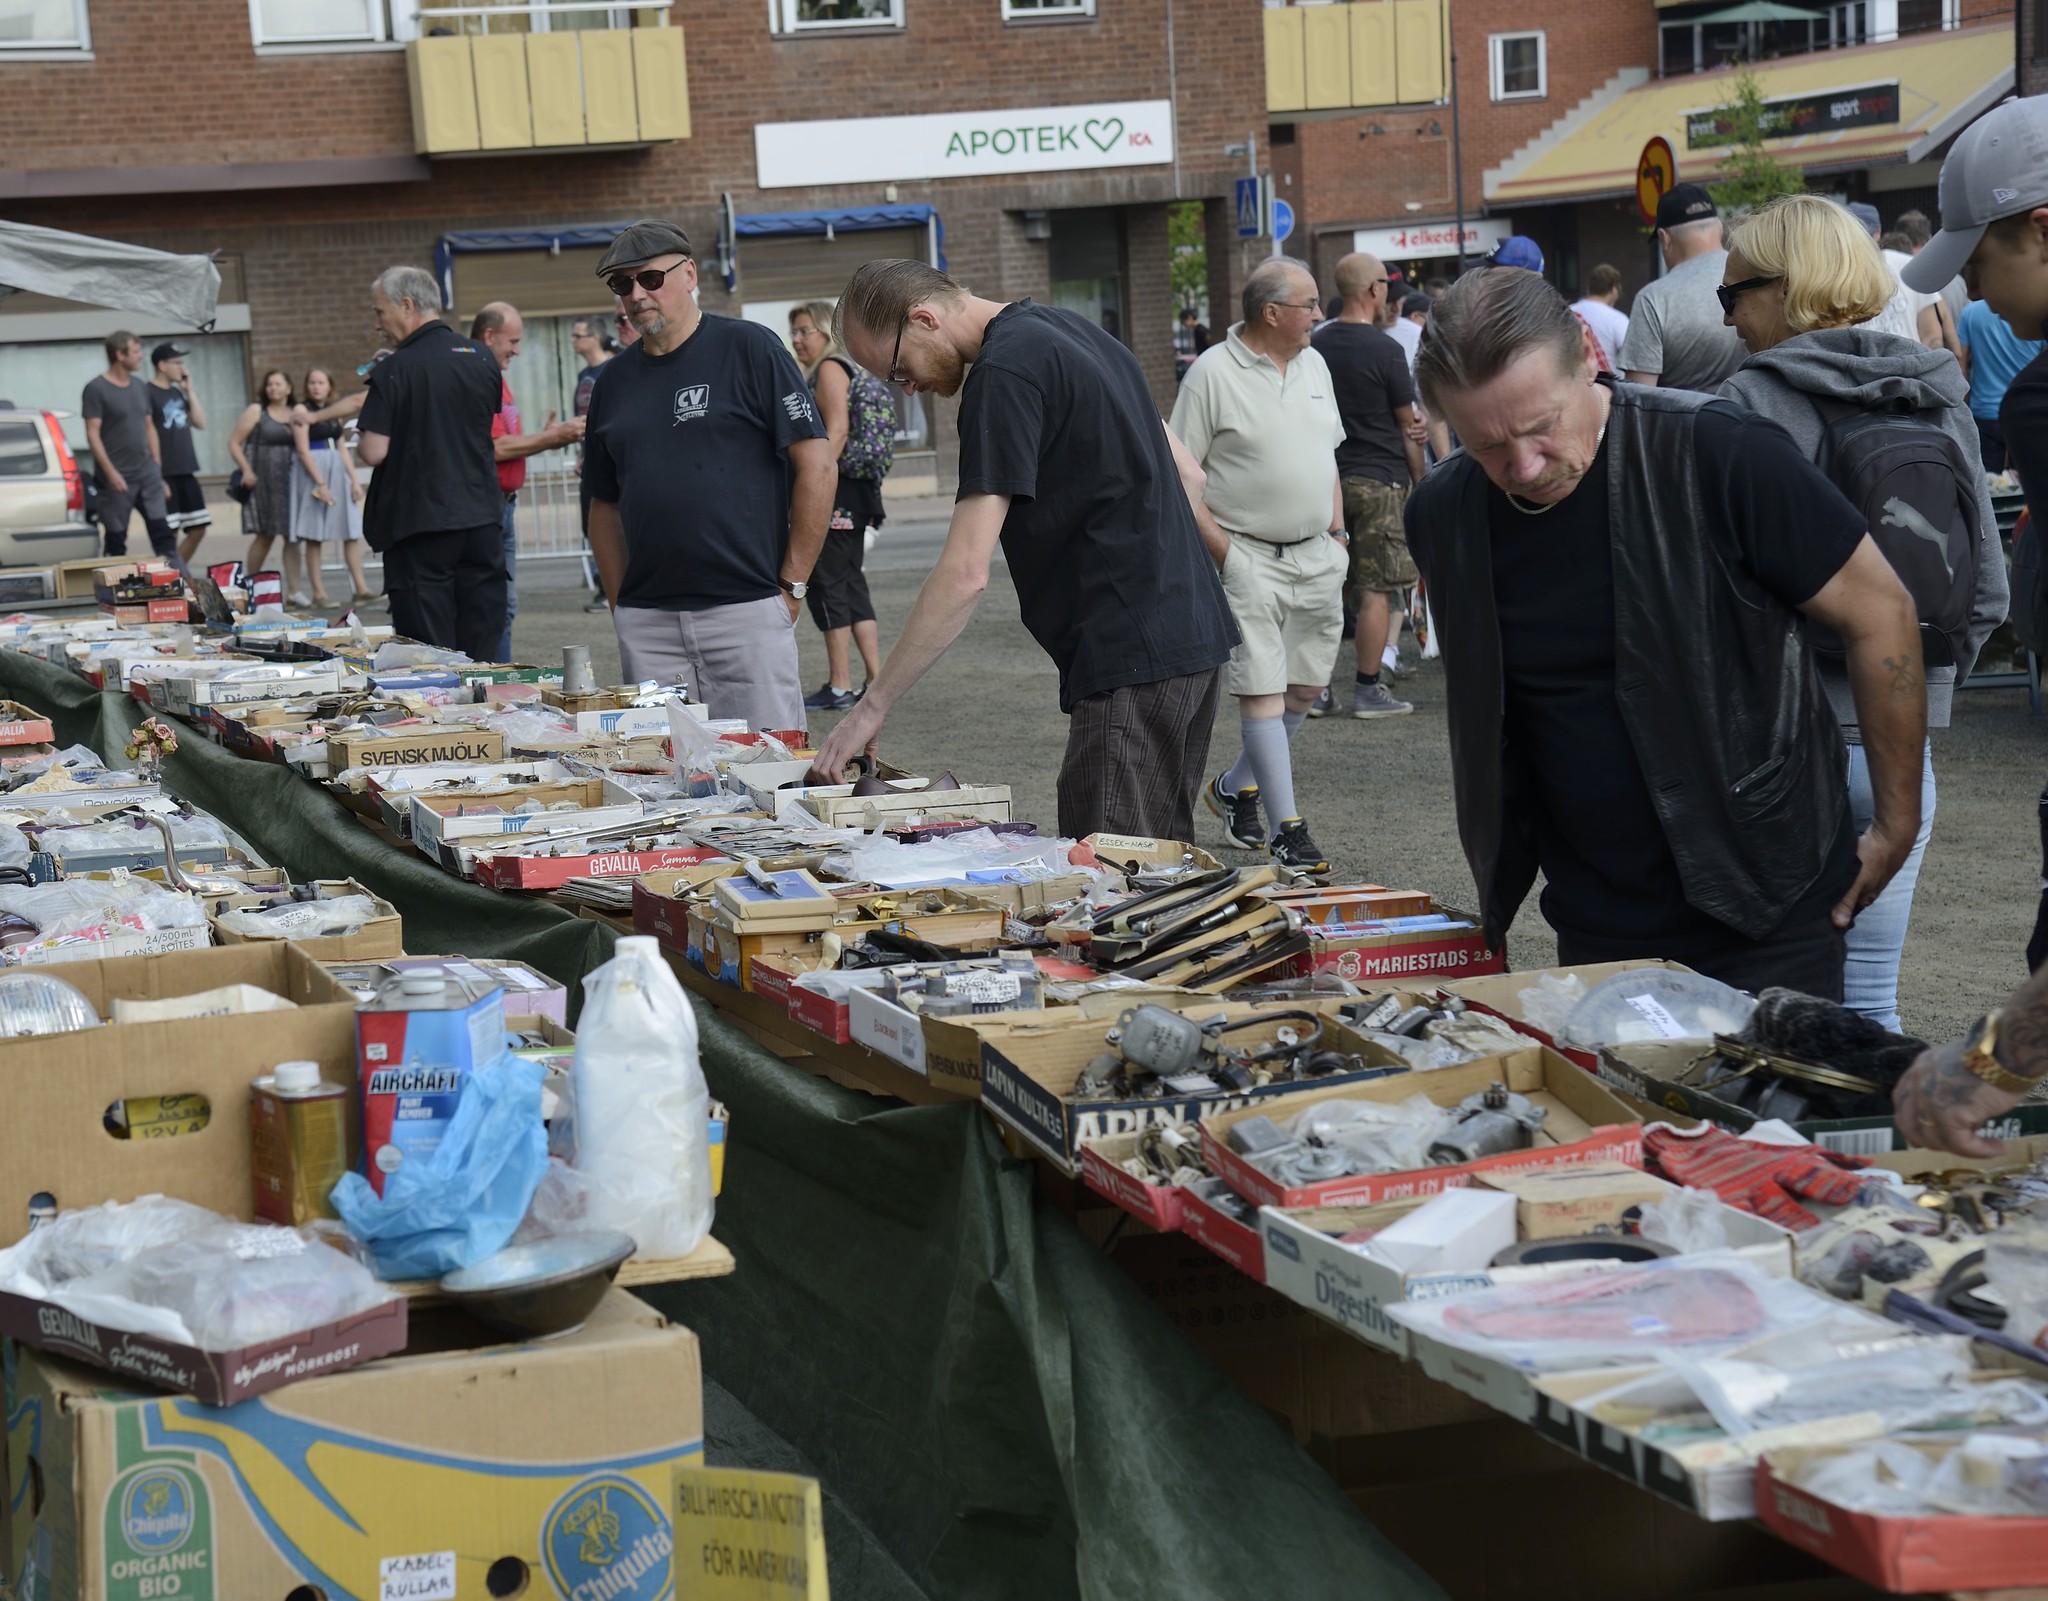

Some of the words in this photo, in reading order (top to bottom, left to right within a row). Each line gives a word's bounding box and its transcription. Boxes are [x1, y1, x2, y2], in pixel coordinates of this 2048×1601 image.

[946, 125, 1079, 157] APOTEK
[1129, 132, 1153, 147] ICA
[678, 387, 705, 407] CV
[361, 748, 429, 767] SVENSK
[431, 742, 490, 762] MJÖLK
[590, 855, 642, 876] GEVALIA
[661, 853, 700, 866] Samma
[160, 938, 196, 953] BOÎTES
[1365, 950, 1469, 976] MARIESTADS
[1473, 950, 1493, 963] 2,8
[368, 1069, 461, 1094] AIRCRAFT
[985, 1059, 1017, 1104] LAPIN
[1016, 1081, 1050, 1129] KULTA
[1315, 1271, 1401, 1341] Digestive
[37, 1306, 102, 1350] GEVALIA
[284, 1343, 360, 1378] MÖRKROST
[127, 1512, 188, 1538] Chiquita
[110, 1549, 208, 1580] ORGANIC
[387, 1553, 453, 1574] KABEL-
[571, 1530, 674, 1601] Chiquita
[702, 1538, 735, 1577] FÖR
[138, 1573, 182, 1600] BIO
[384, 1576, 451, 1600] RULLAR
